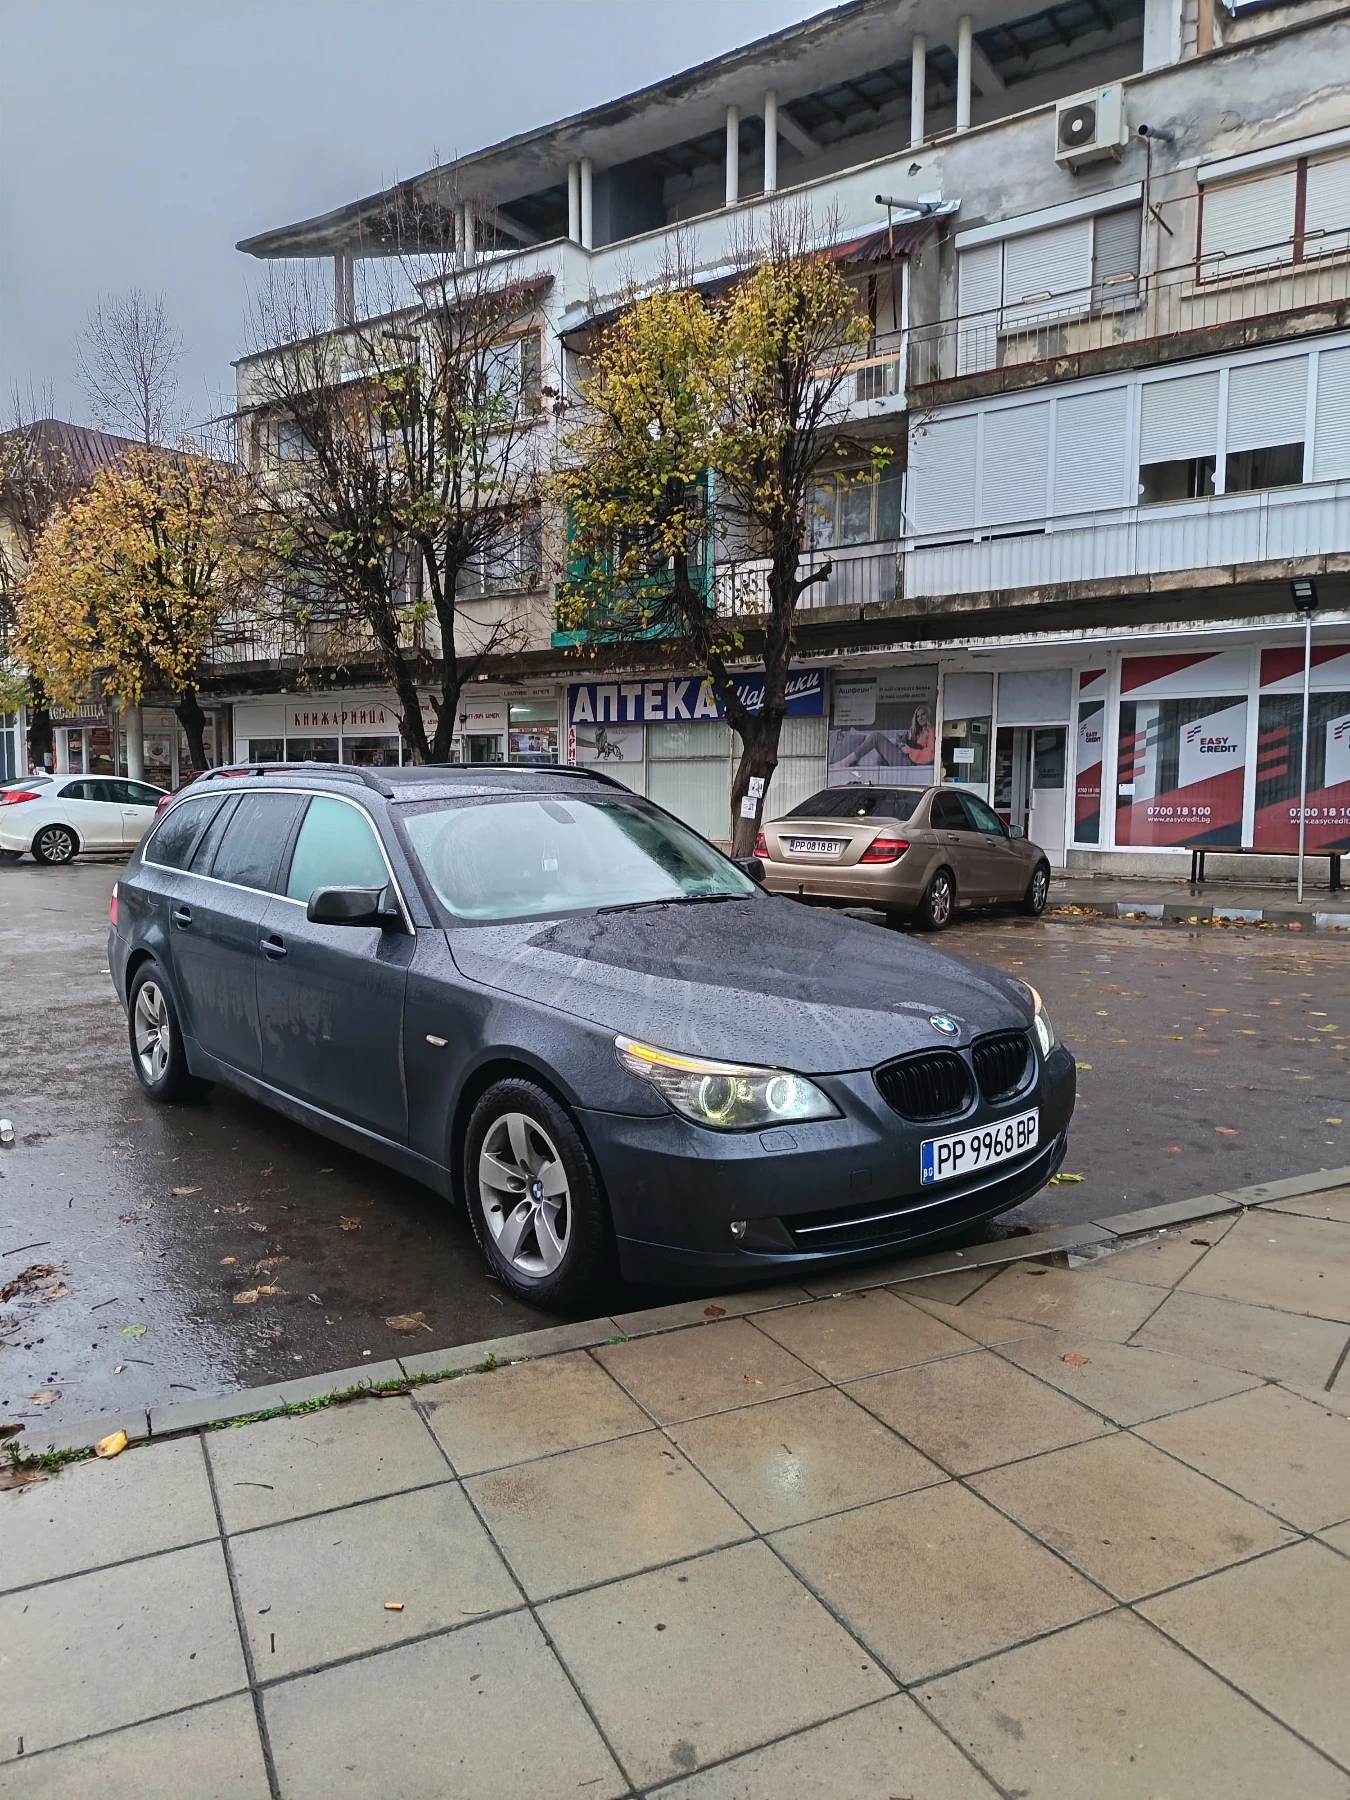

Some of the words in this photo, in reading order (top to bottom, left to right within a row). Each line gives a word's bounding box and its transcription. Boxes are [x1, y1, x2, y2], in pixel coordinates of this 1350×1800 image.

[572, 680, 719, 723] АПТЕКА
[295, 710, 385, 726] КНИЖАРНИЦА
[1200, 737, 1229, 746] EASY
[1200, 745, 1238, 753] CREDIT
[1147, 806, 1173, 815] 0700
[1176, 806, 1189, 815] 18
[1191, 806, 1211, 815] 100
[1322, 808, 1336, 817] 18
[1147, 816, 1211, 824] www.easycredit.bg
[795, 841, 806, 850] PP
[806, 842, 826, 851] 0818
[827, 843, 839, 852] BT
[938, 1139, 966, 1175] PP
[970, 1125, 1014, 1165] 9968
[1016, 1116, 1036, 1149] BP
